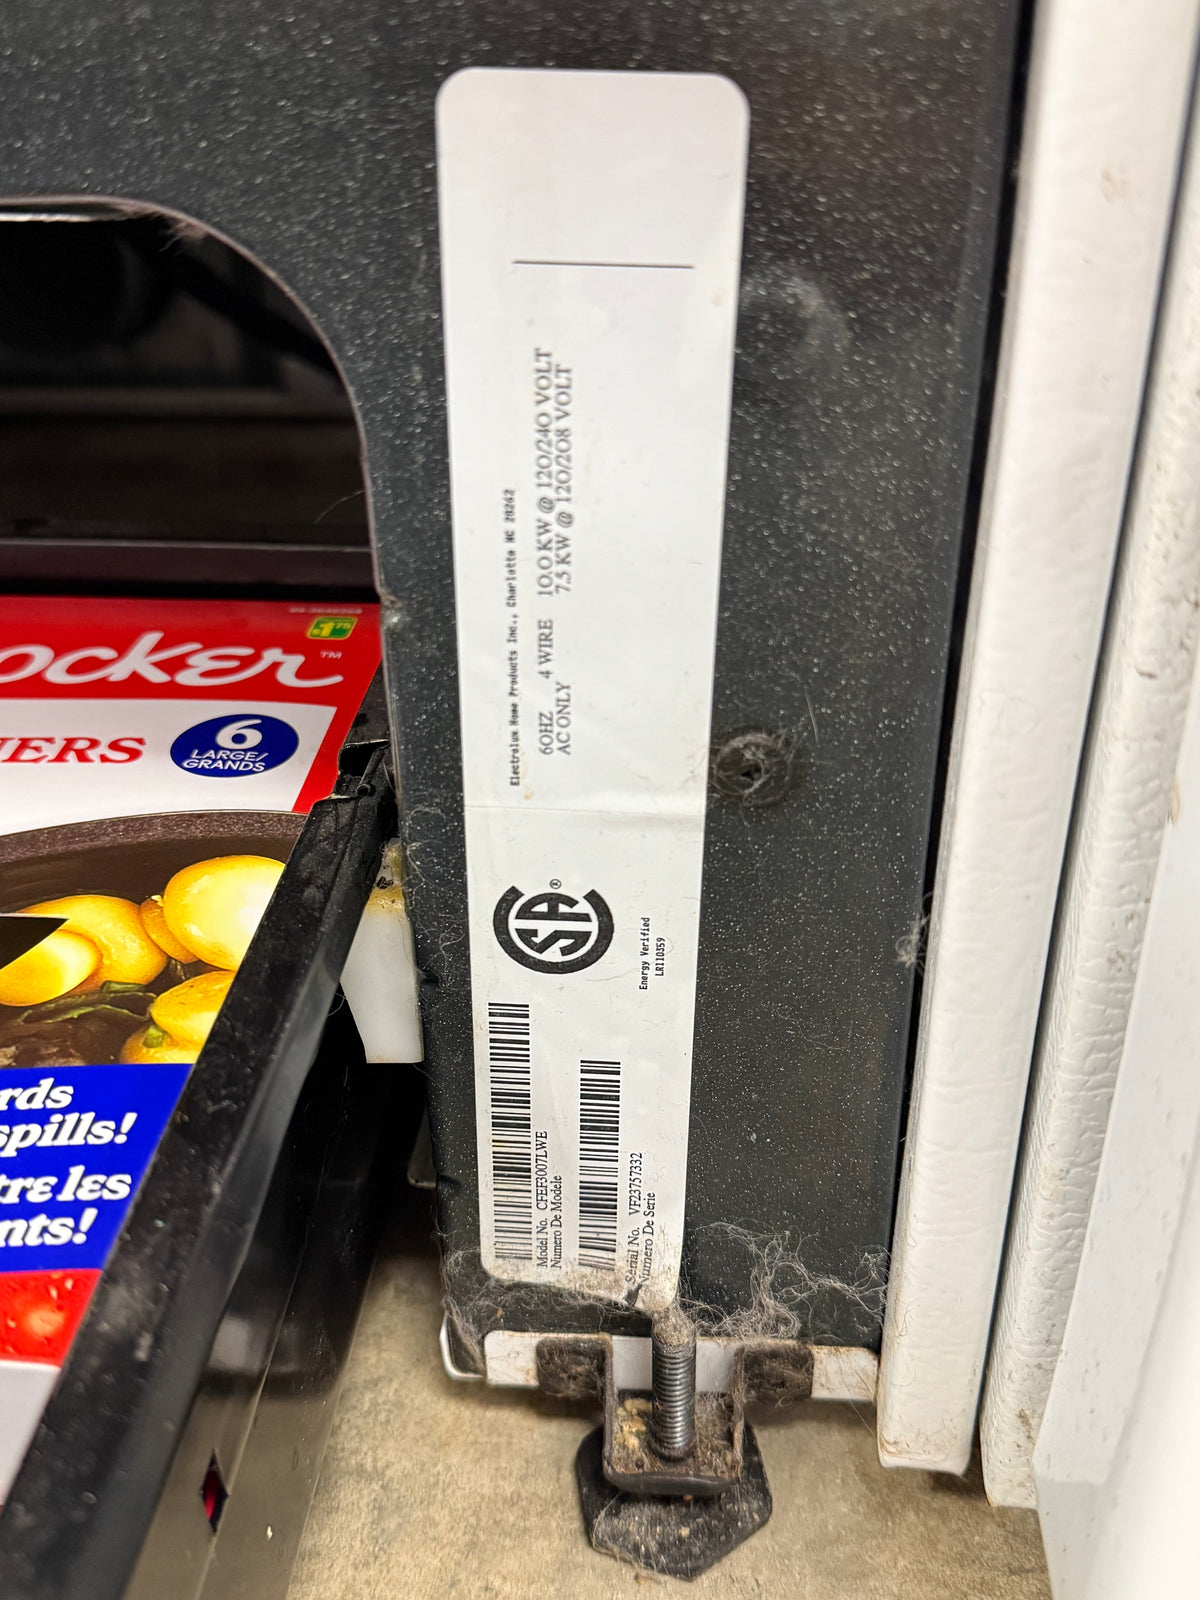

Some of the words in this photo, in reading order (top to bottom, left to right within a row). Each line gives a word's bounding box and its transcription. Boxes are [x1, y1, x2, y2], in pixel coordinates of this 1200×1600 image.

[535, 348, 552, 406] VOLT
[555, 364, 572, 420] VOLT
[535, 412, 553, 489] 120/240
[554, 427, 572, 503] 120/208
[536, 497, 554, 513] @
[555, 512, 574, 528] @
[505, 531, 515, 543] NC
[536, 519, 552, 551] KW
[555, 533, 571, 566] KW
[506, 550, 517, 607] Charlotte
[536, 556, 553, 596] 10.0
[555, 571, 571, 594] 7.5
[507, 614, 519, 643] Inc.,
[538, 619, 553, 665] WIRE
[508, 650, 518, 697] Products
[538, 671, 553, 679] 4
[510, 703, 519, 726] Home
[556, 681, 571, 728] ONLY
[215, 718, 263, 750] 6
[557, 732, 571, 755] AC
[181, 757, 266, 772] GRANDS
[190, 748, 268, 762] LARGE/
[510, 731, 520, 786] Electrolux
[639, 917, 650, 956] Verified
[655, 937, 666, 976] LR110359
[639, 961, 649, 990] Energy
[56, 1164, 132, 1202] les
[536, 1131, 547, 1210] CFEF3007LWE
[628, 1152, 642, 1215] VF23757332
[551, 1175, 562, 1212] Modele
[643, 1192, 656, 1218] Serie
[537, 1218, 547, 1235] No.
[551, 1214, 562, 1228] De
[628, 1227, 640, 1247] No.
[643, 1220, 654, 1236] De
[537, 1238, 548, 1268] Model
[551, 1230, 562, 1269] Numero
[625, 1250, 639, 1285] Serial
